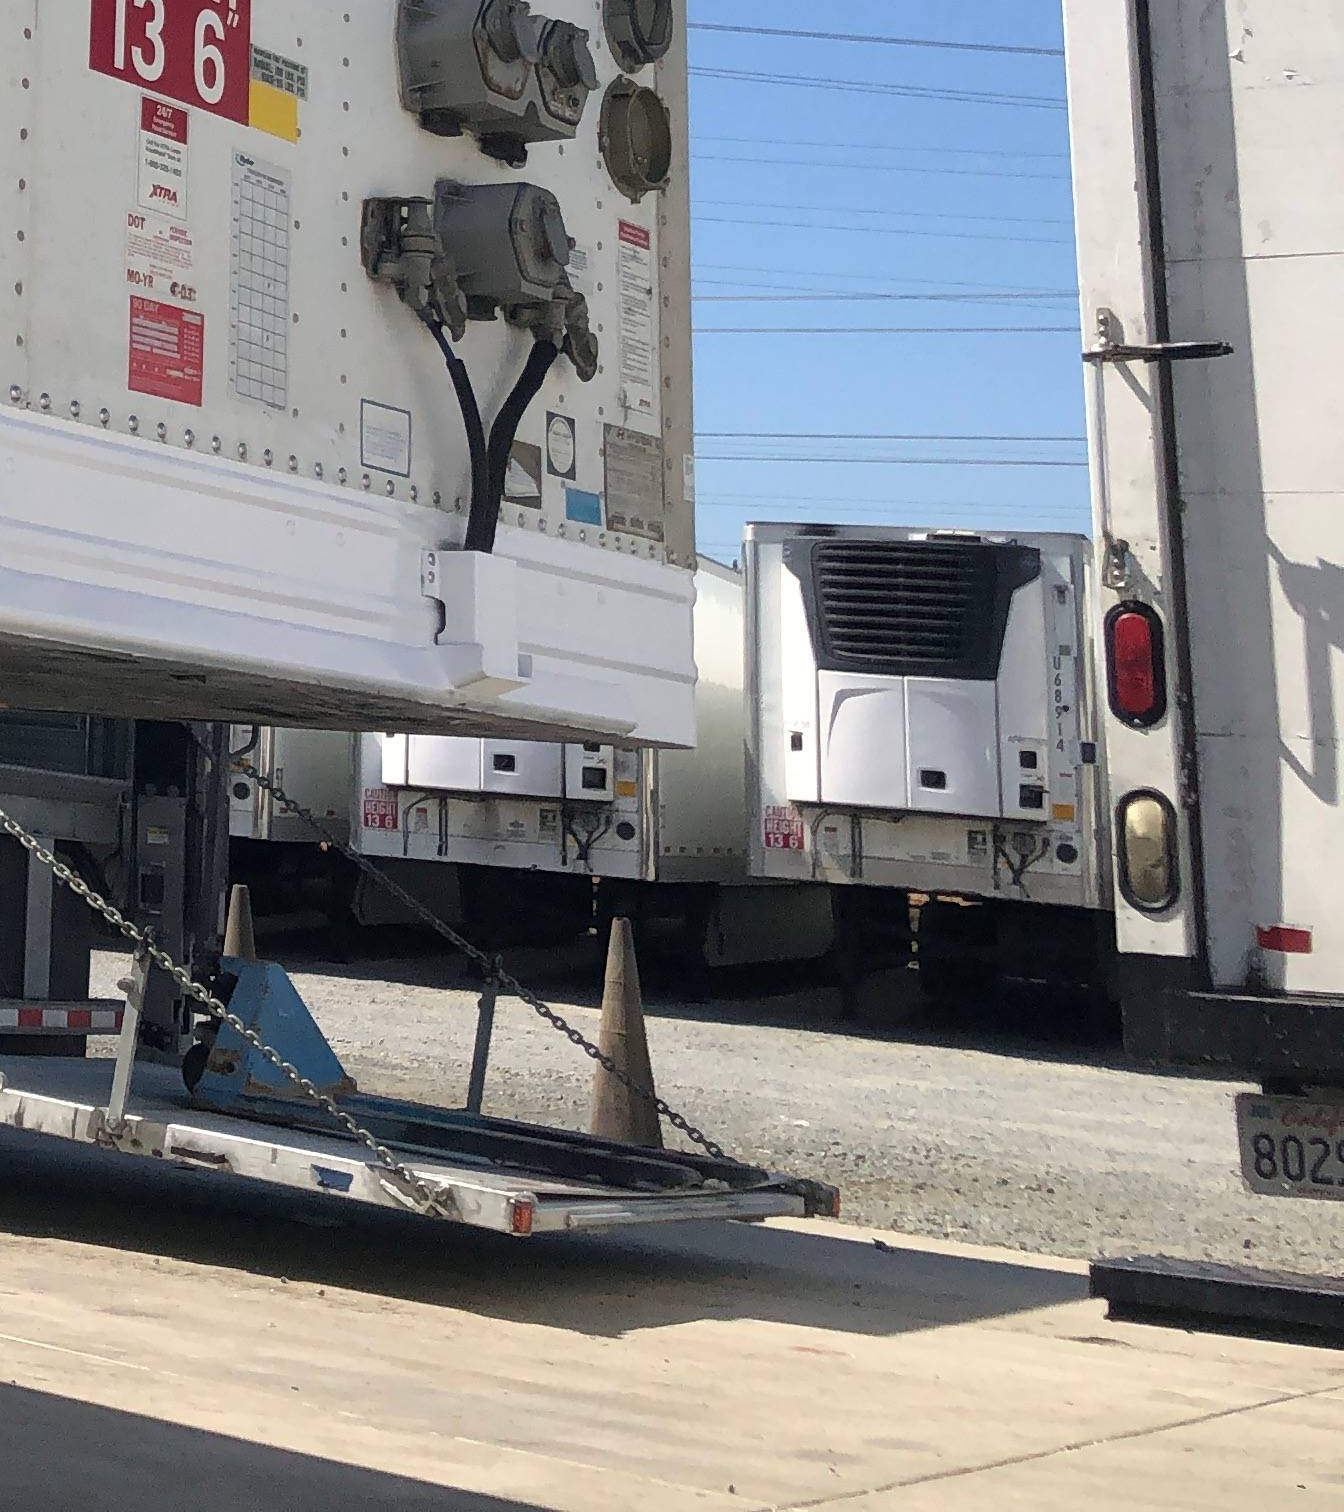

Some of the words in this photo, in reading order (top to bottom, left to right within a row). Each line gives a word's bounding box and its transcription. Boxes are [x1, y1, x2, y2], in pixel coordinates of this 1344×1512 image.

[149, 184, 178, 204] XTRA
[127, 213, 146, 231] DOT
[365, 801, 395, 816] HEIGHT
[766, 819, 801, 836] HEIGHT
